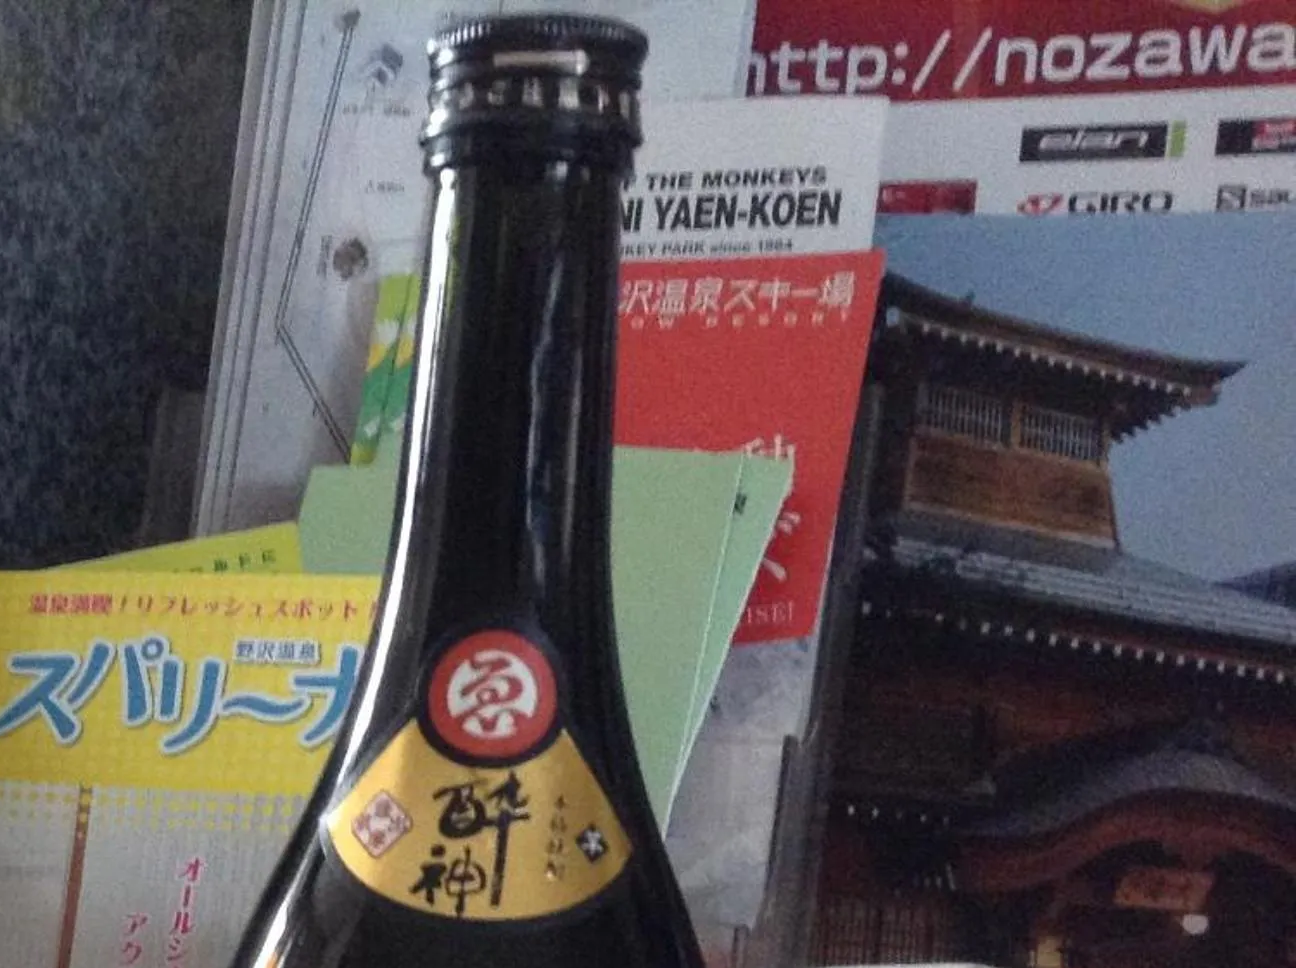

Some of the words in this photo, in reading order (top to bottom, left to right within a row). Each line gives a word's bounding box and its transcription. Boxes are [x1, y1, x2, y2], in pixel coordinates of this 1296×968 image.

[646, 172, 693, 191] THE
[700, 166, 827, 189] MONKEYS
[654, 188, 842, 230] YAEN-KOEN
[1068, 190, 1174, 213] GIRO
